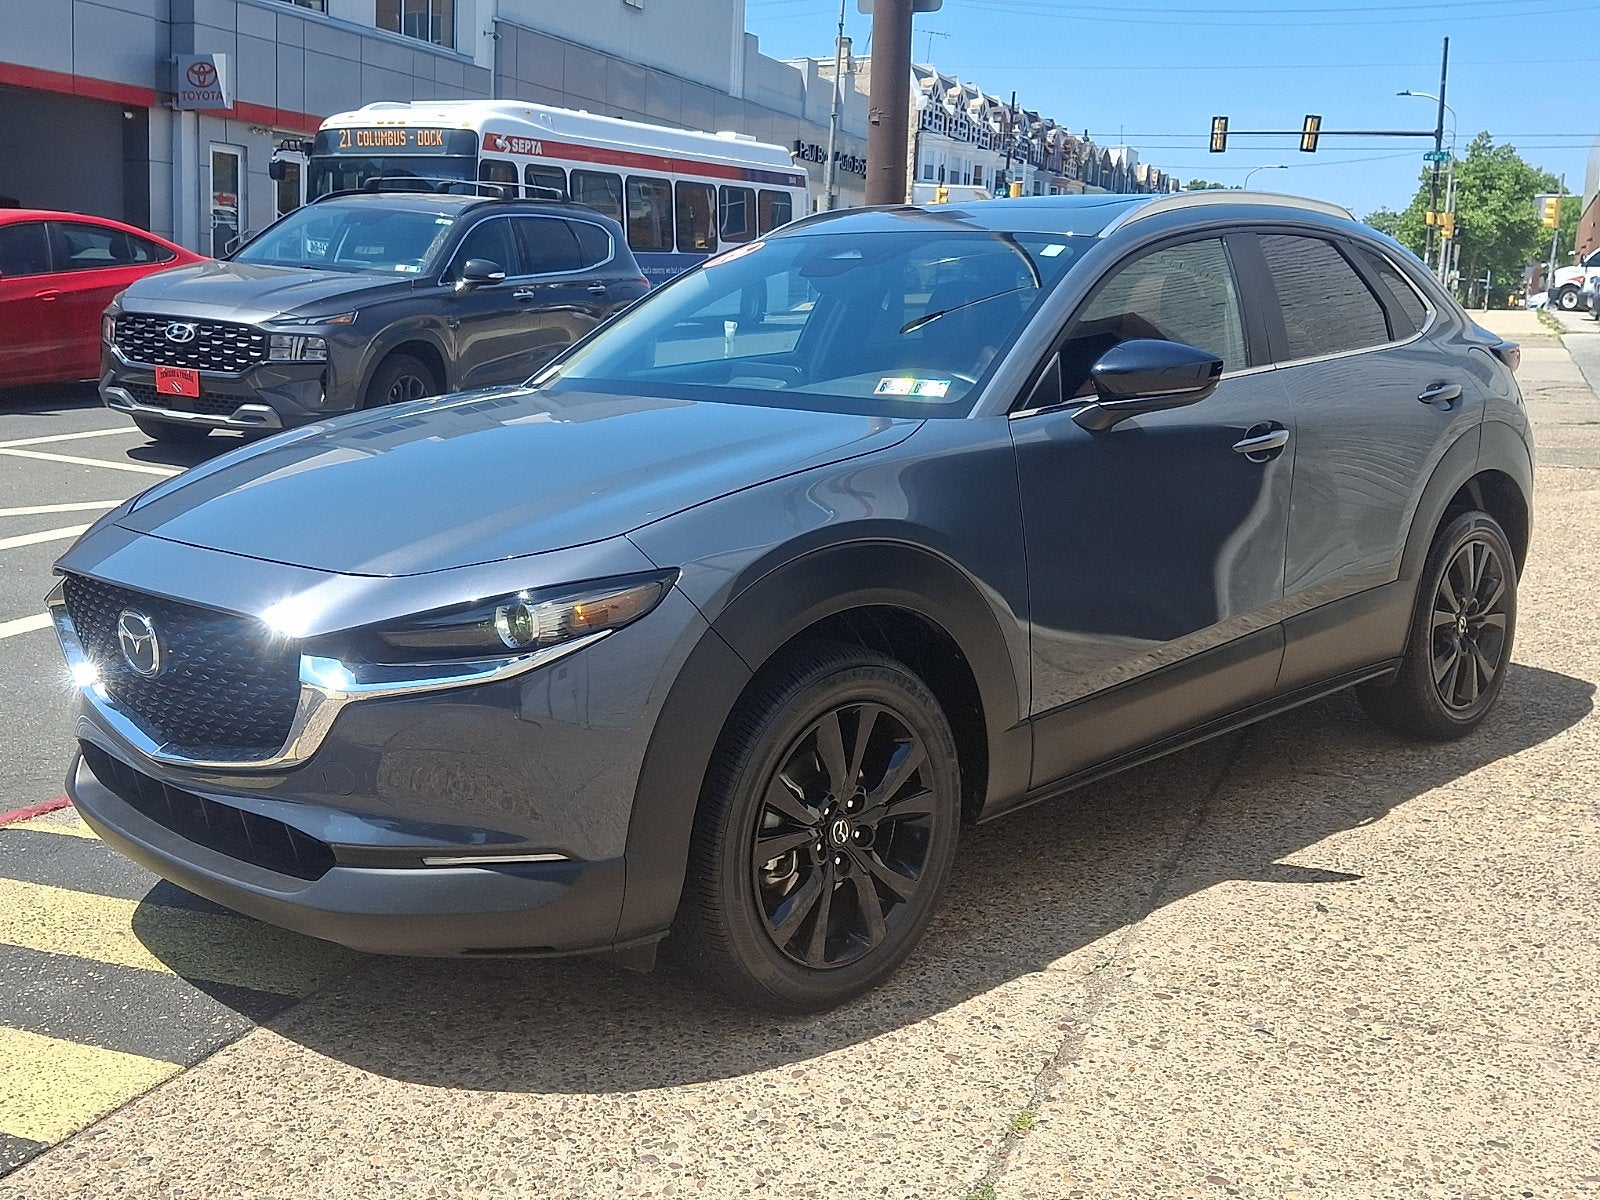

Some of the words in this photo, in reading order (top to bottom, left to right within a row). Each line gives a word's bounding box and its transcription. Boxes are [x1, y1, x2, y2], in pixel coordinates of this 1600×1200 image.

[181, 91, 223, 102] TOYOTA
[339, 129, 352, 148] 21
[356, 129, 408, 148] COLUMBUS
[417, 129, 444, 147] DOCK
[511, 138, 544, 155] SEPTA
[800, 141, 817, 161] Paul
